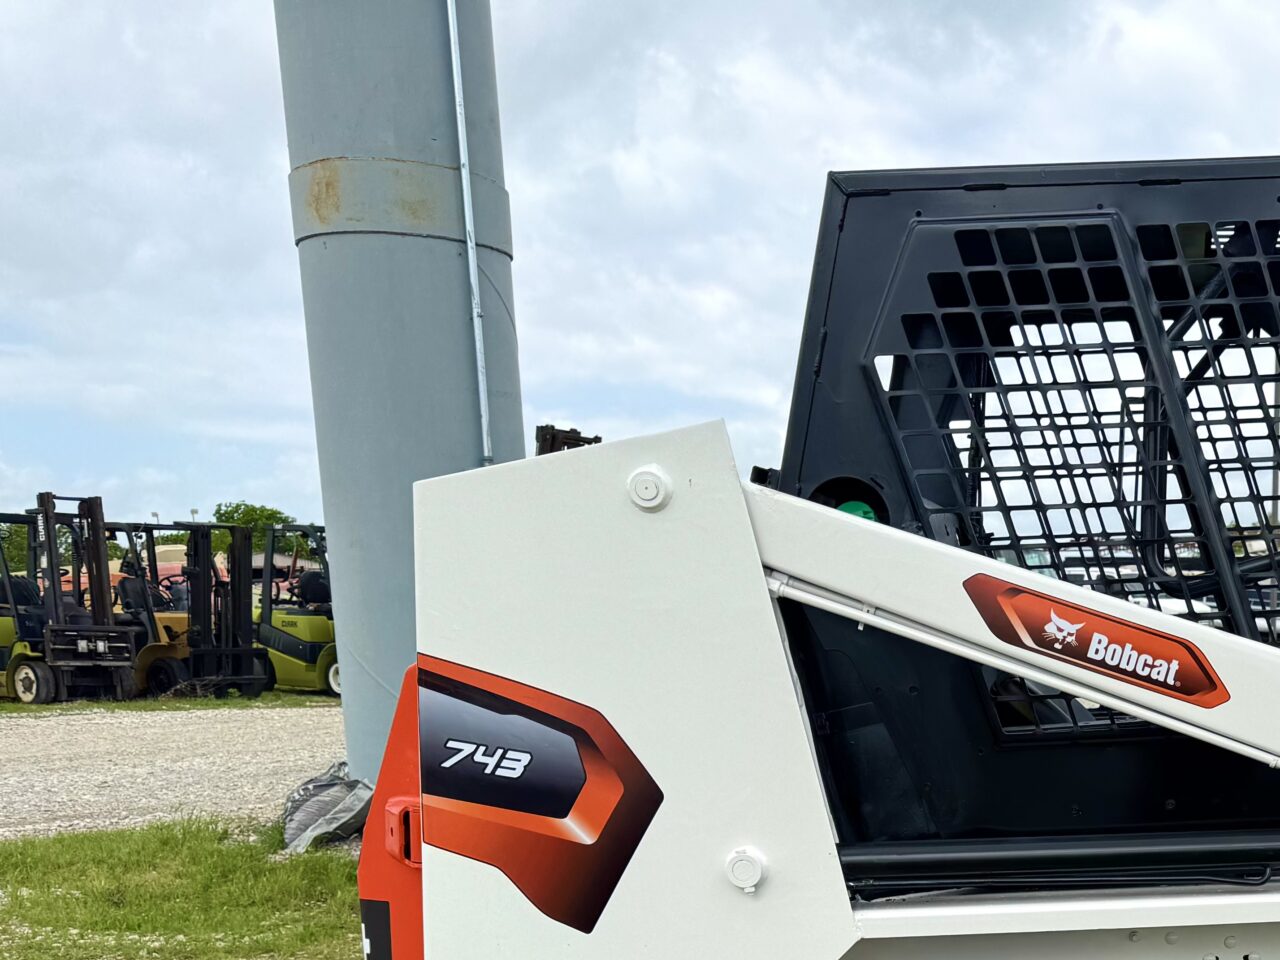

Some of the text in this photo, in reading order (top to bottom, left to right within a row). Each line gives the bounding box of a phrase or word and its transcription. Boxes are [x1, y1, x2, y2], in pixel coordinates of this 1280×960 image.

[37, 513, 46, 541] CLARK
[1087, 631, 1180, 685] Bobcat
[440, 739, 532, 779] 743
